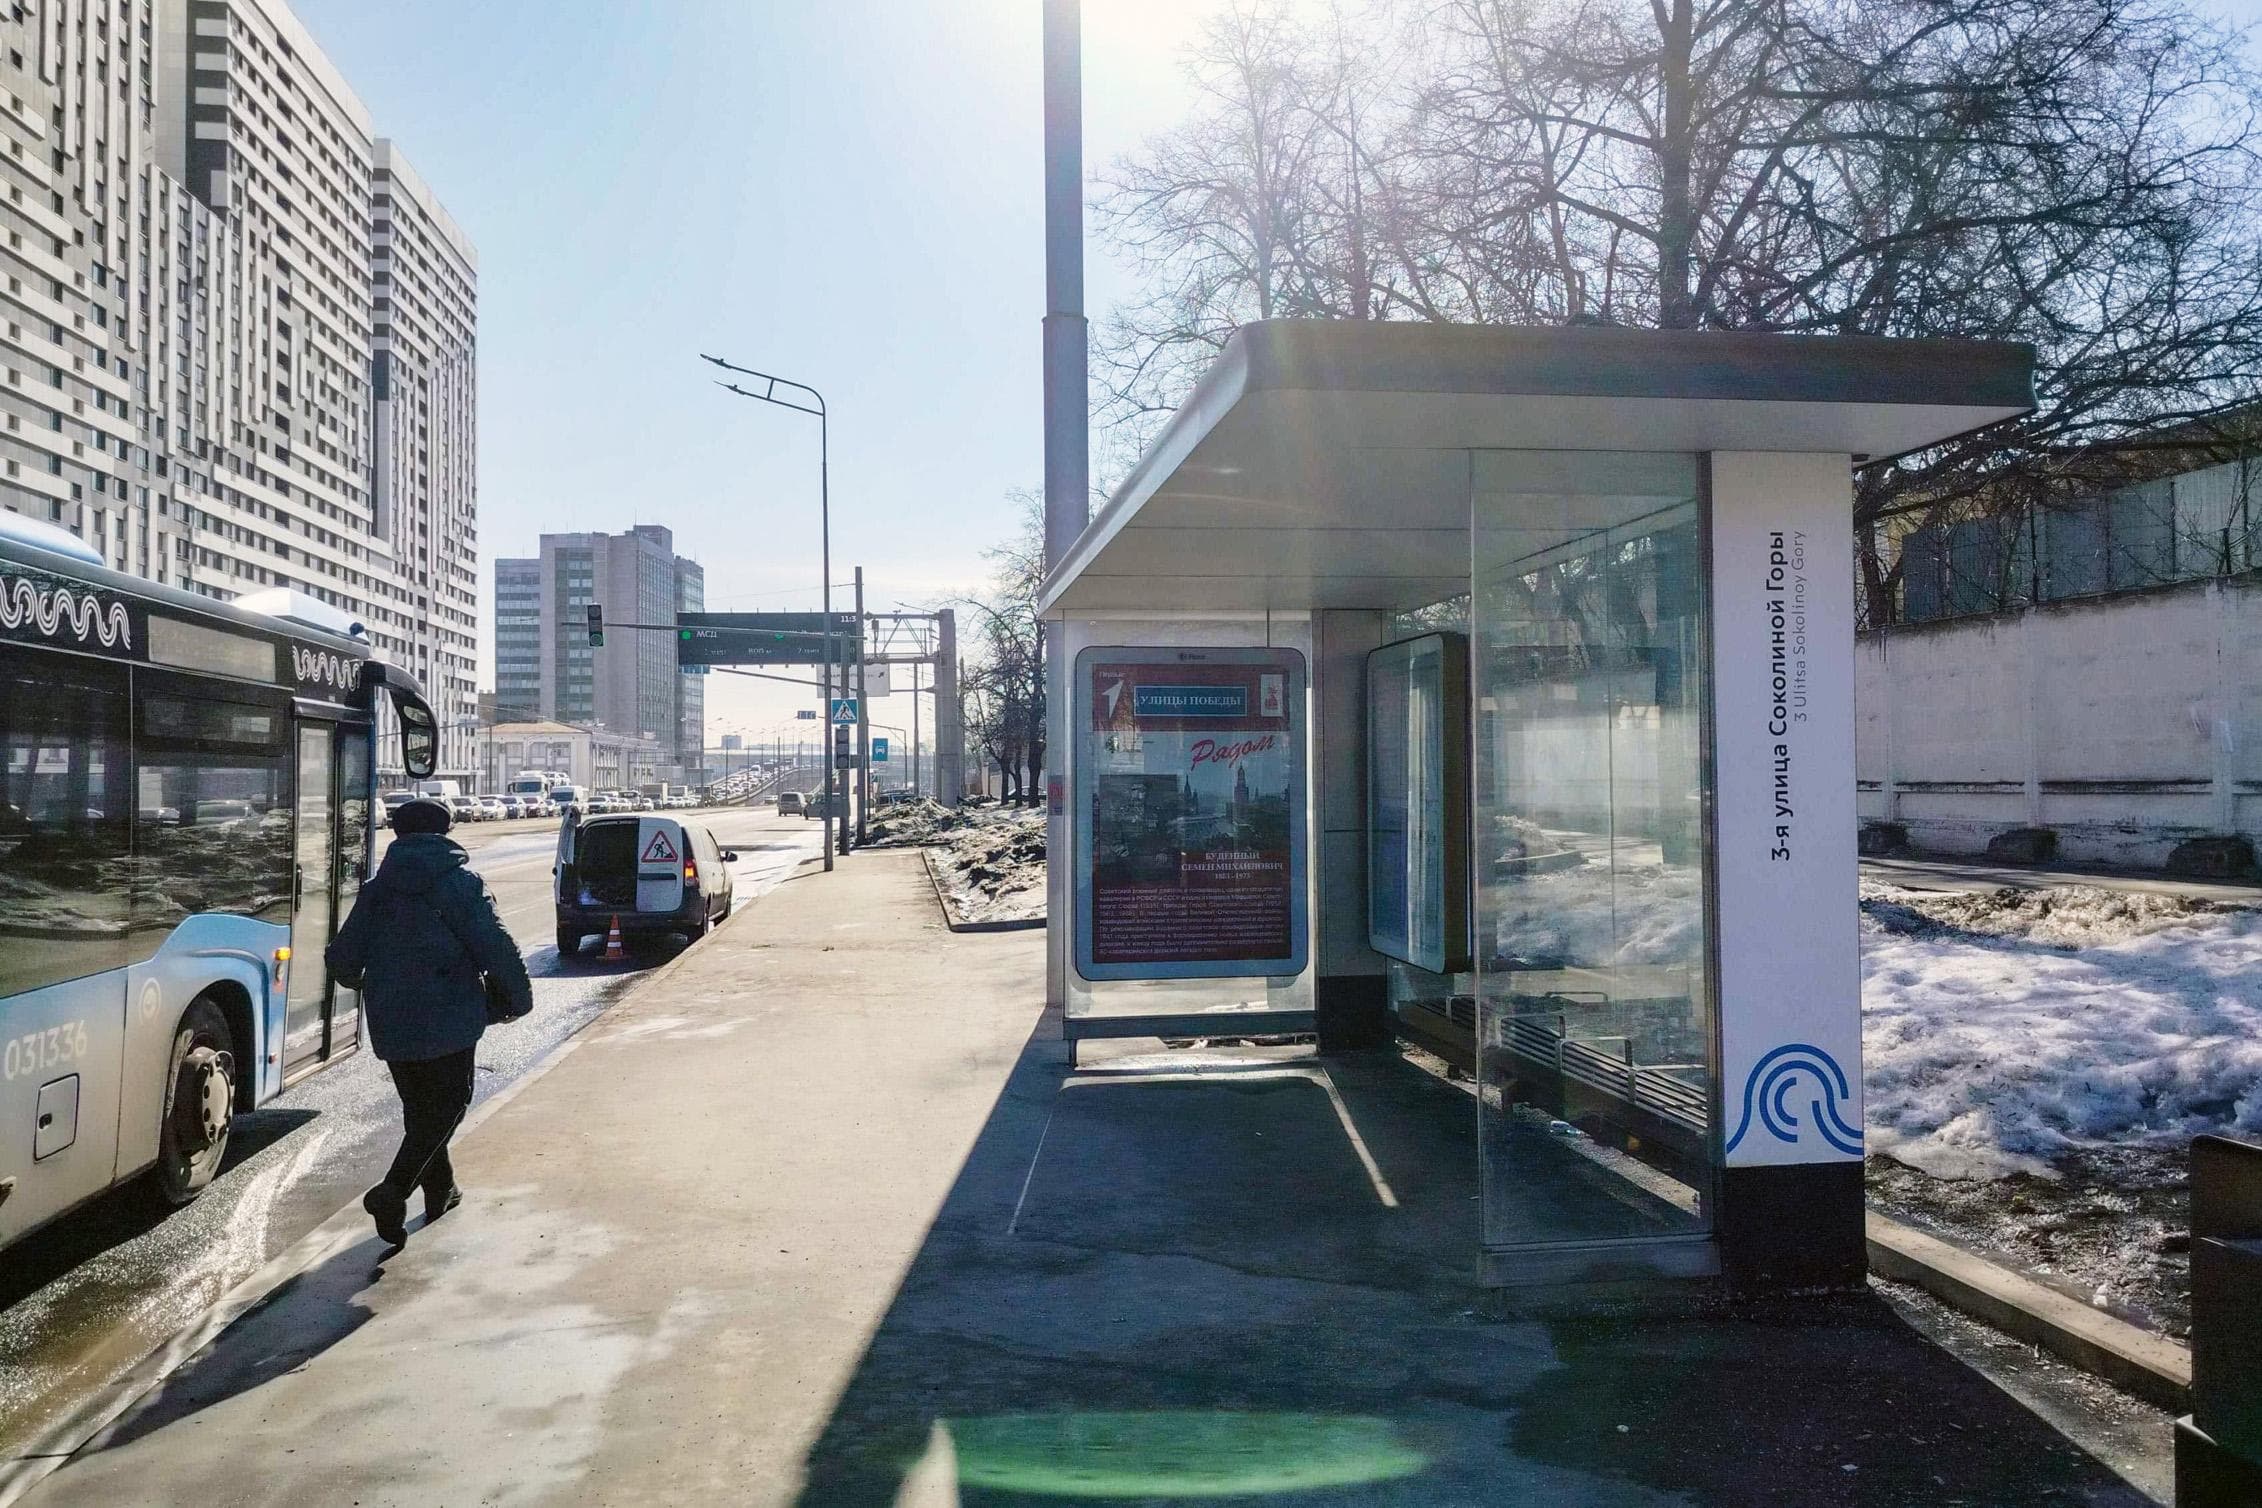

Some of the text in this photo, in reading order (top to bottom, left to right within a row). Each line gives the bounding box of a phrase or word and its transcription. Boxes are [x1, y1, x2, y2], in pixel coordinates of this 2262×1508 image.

[840, 615, 857, 623] 11:3
[1791, 530, 1809, 722] 3 Ulitsa Sokolinoy Gory
[1139, 695, 1241, 708] УЛИЦЫ ПОБЕДЫ
[1766, 530, 1794, 861] 3-я улица Соколиной Горы
[5, 1020, 87, 1080] 031336
